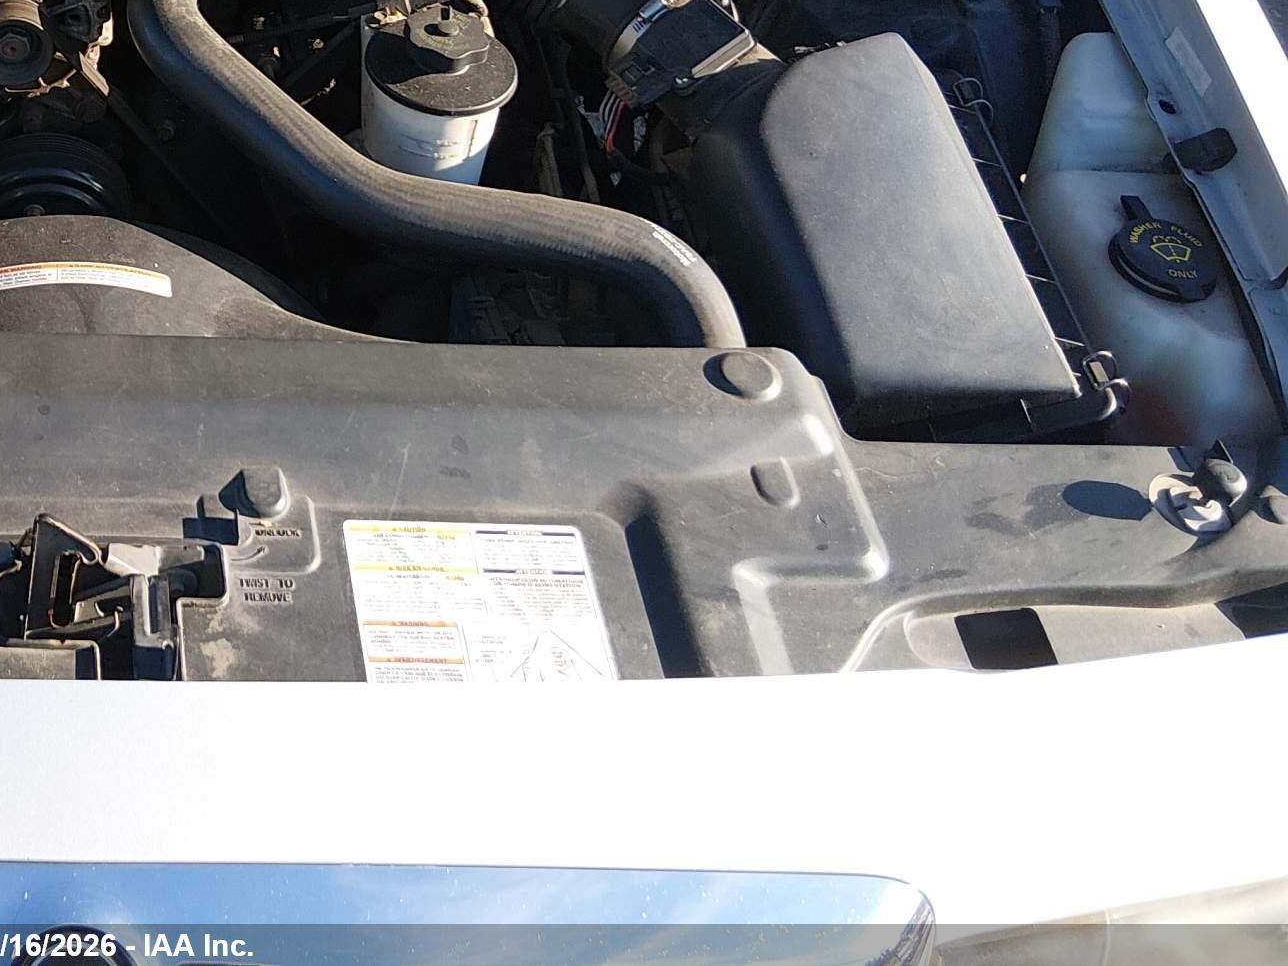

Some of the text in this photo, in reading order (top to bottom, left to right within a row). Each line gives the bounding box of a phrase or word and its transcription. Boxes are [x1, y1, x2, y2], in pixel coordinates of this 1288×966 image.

[1129, 222, 1202, 247] WASHER FLUID
[1168, 268, 1198, 278] ONLY
[239, 578, 296, 589] TWIST TO
[243, 592, 293, 603] REMOVE
